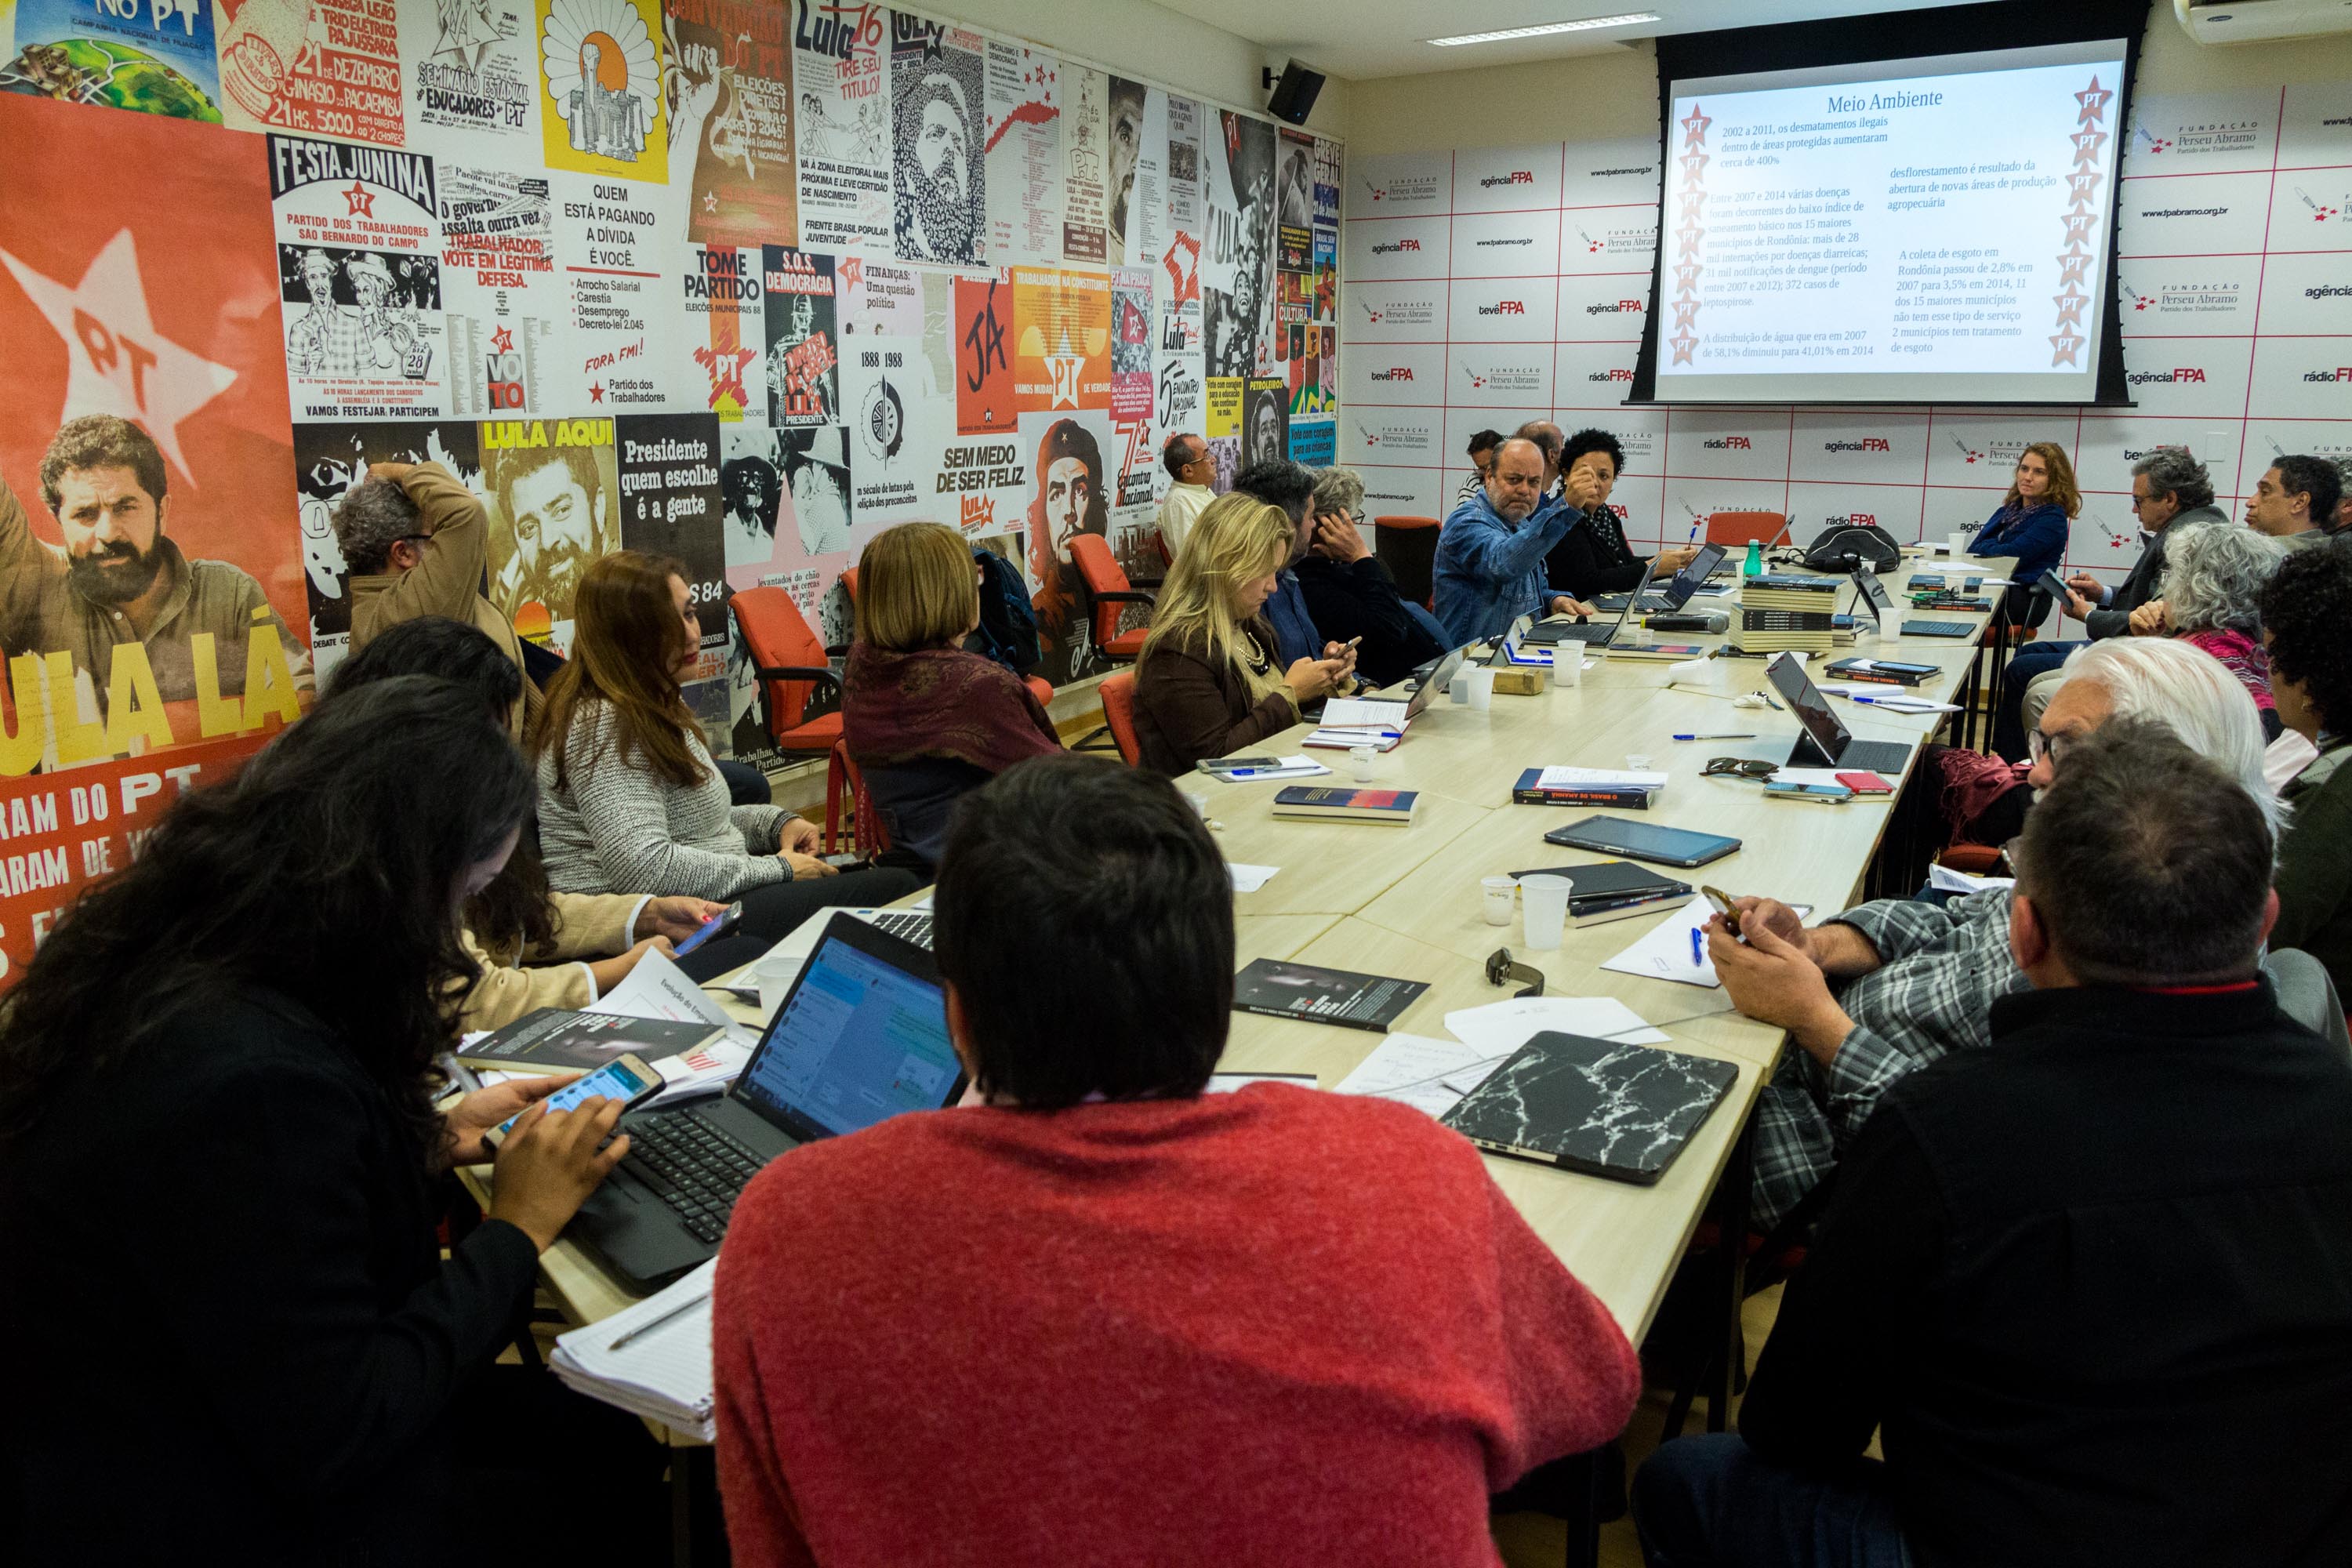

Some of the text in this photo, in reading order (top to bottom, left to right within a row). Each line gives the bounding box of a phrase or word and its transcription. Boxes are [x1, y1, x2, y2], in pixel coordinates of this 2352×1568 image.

[295, 38, 401, 93] 21 DE DEZEMBRO
[835, 60, 860, 78] TIRE
[862, 56, 881, 74] SEU
[282, 76, 336, 105] GINÁSIO
[418, 61, 529, 104] SEMINÁRIO ESTADUAL
[840, 74, 881, 102] TÍTULO!
[426, 89, 495, 120] EDUCADORES
[506, 101, 526, 127] PT
[1828, 89, 1943, 113] Meio Ambiente
[1722, 127, 1744, 138] 2002
[1752, 125, 1775, 137] 2011,
[1778, 125, 1788, 134] os
[1790, 119, 1857, 133] desmatamentos
[1859, 116, 1888, 129] ilegais
[2179, 121, 2257, 132] FUNDAÇÃO
[1722, 133, 1888, 152] dentro de áreas protegidas aumentaram
[2178, 132, 2256, 147] Perseu Abramo
[272, 136, 436, 215] FESTA JUNINA
[1591, 166, 1653, 177] www.fpabramo.org.br
[1890, 159, 2035, 178] desflorestamento é resultado da
[1480, 171, 1534, 188] agênciaFPA
[593, 183, 628, 202] QUEM
[348, 191, 368, 213] PT
[1887, 198, 1945, 212] agropecuária
[564, 202, 655, 227] ESTÁ PAGANDO
[2142, 207, 2229, 218] www.fpabramo.org.br
[287, 213, 429, 238] PARTIDO DOS TRABALHADORES
[805, 220, 888, 237] FRENTE BRASIL POPULAR
[299, 227, 419, 249] SÃO BERNARDO DO CAMPO
[586, 225, 636, 245] A DÍVIDA
[805, 233, 847, 246] JUVENTUDE
[1476, 237, 1533, 248] www.fpabramo.org.br
[1372, 239, 1421, 256] agênciaFPA
[1900, 248, 1998, 260] A coleta de esgoto em
[442, 250, 474, 268] VOTE
[478, 253, 496, 269] EM
[590, 247, 636, 267] É VOCÊ.
[696, 250, 746, 277] TOME
[782, 252, 815, 271] S.O.S.
[477, 270, 528, 289] DEFESA.
[765, 270, 833, 296] DEMOCRACIA
[866, 266, 910, 283] FINANÇAS:
[1016, 271, 1109, 292] TRABALHADOR NA CONSTITUINTE
[576, 278, 641, 292] Arrocho Salarial
[684, 277, 760, 300] PARTIDO
[866, 281, 915, 297] Uma questão
[577, 291, 612, 304] Carestia
[866, 296, 895, 310] política
[1587, 299, 1642, 314] agênciaFPA
[2161, 293, 2238, 305] Perseu Abramo
[578, 304, 630, 319] Desemprego
[685, 302, 760, 315] ELEIÇÕES MUNICIPAIS 88
[1279, 306, 1308, 323] CULTURA
[1479, 300, 1525, 315] tevêFPA
[579, 318, 644, 330] Decreto-lei 2.045
[964, 278, 1007, 392] JÁ
[586, 337, 644, 374] FORA FMI!
[861, 352, 902, 368] 1888 1988
[716, 354, 739, 382] PT
[1371, 368, 1414, 382] tevêFPA
[1588, 369, 1632, 383] rádioFPA
[2127, 368, 2206, 386] agênciaFPA
[608, 379, 653, 391] Partido dos
[1054, 358, 1076, 397] PT
[1173, 379, 1200, 394] ENCONTRO
[1249, 379, 1283, 391] PETROLEIROS
[609, 391, 666, 404] Trabalhadores
[1014, 383, 1111, 394] VAMOS MUDAR DE VERDADE
[306, 405, 339, 417] VAMOS
[389, 406, 440, 418] PARTICIPEM
[786, 394, 822, 416] LULA
[1172, 394, 1197, 411] NACIONAL
[786, 414, 823, 425] PRESIDENTE
[483, 421, 613, 450] LULA AQUI
[1704, 436, 1751, 450] rádioFPA
[625, 438, 707, 463] Presidente
[1824, 438, 1890, 453] agênciaFPA
[943, 444, 1016, 468] SEM MEDO
[622, 464, 718, 496] quem escolhe
[936, 466, 1025, 494] DE SER FELIZ.
[1364, 491, 1415, 502] www.fpabramo.org.br
[637, 494, 706, 523] é a gente
[314, 638, 337, 649] DEBATE
[191, 604, 303, 738] LÁ
[70, 782, 108, 826] DO
[661, 978, 684, 1002] Evolução
